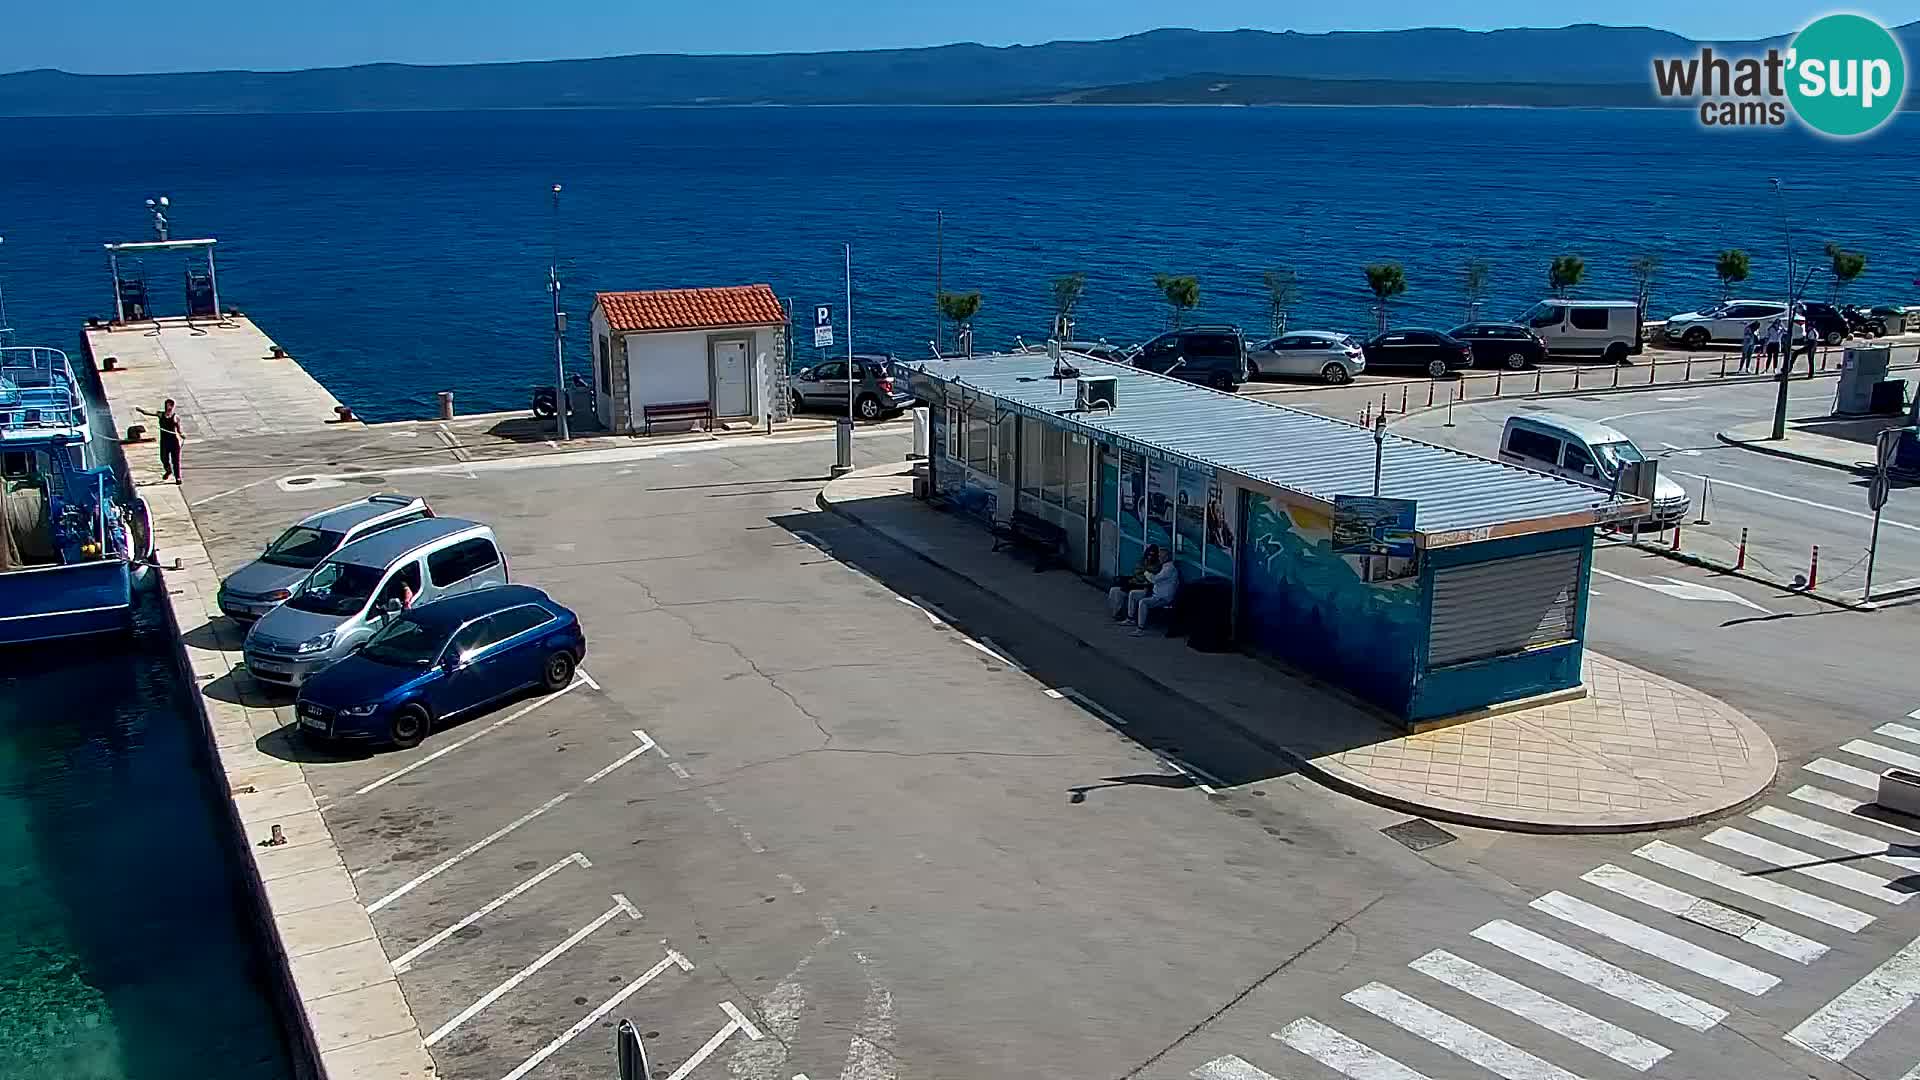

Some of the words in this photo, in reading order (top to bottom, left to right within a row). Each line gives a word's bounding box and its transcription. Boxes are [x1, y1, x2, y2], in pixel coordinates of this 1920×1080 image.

[818, 307, 828, 324] P
[1131, 442, 1161, 459] STATION
[1163, 451, 1187, 468] TICKET
[1188, 460, 1214, 475] OFFICE
